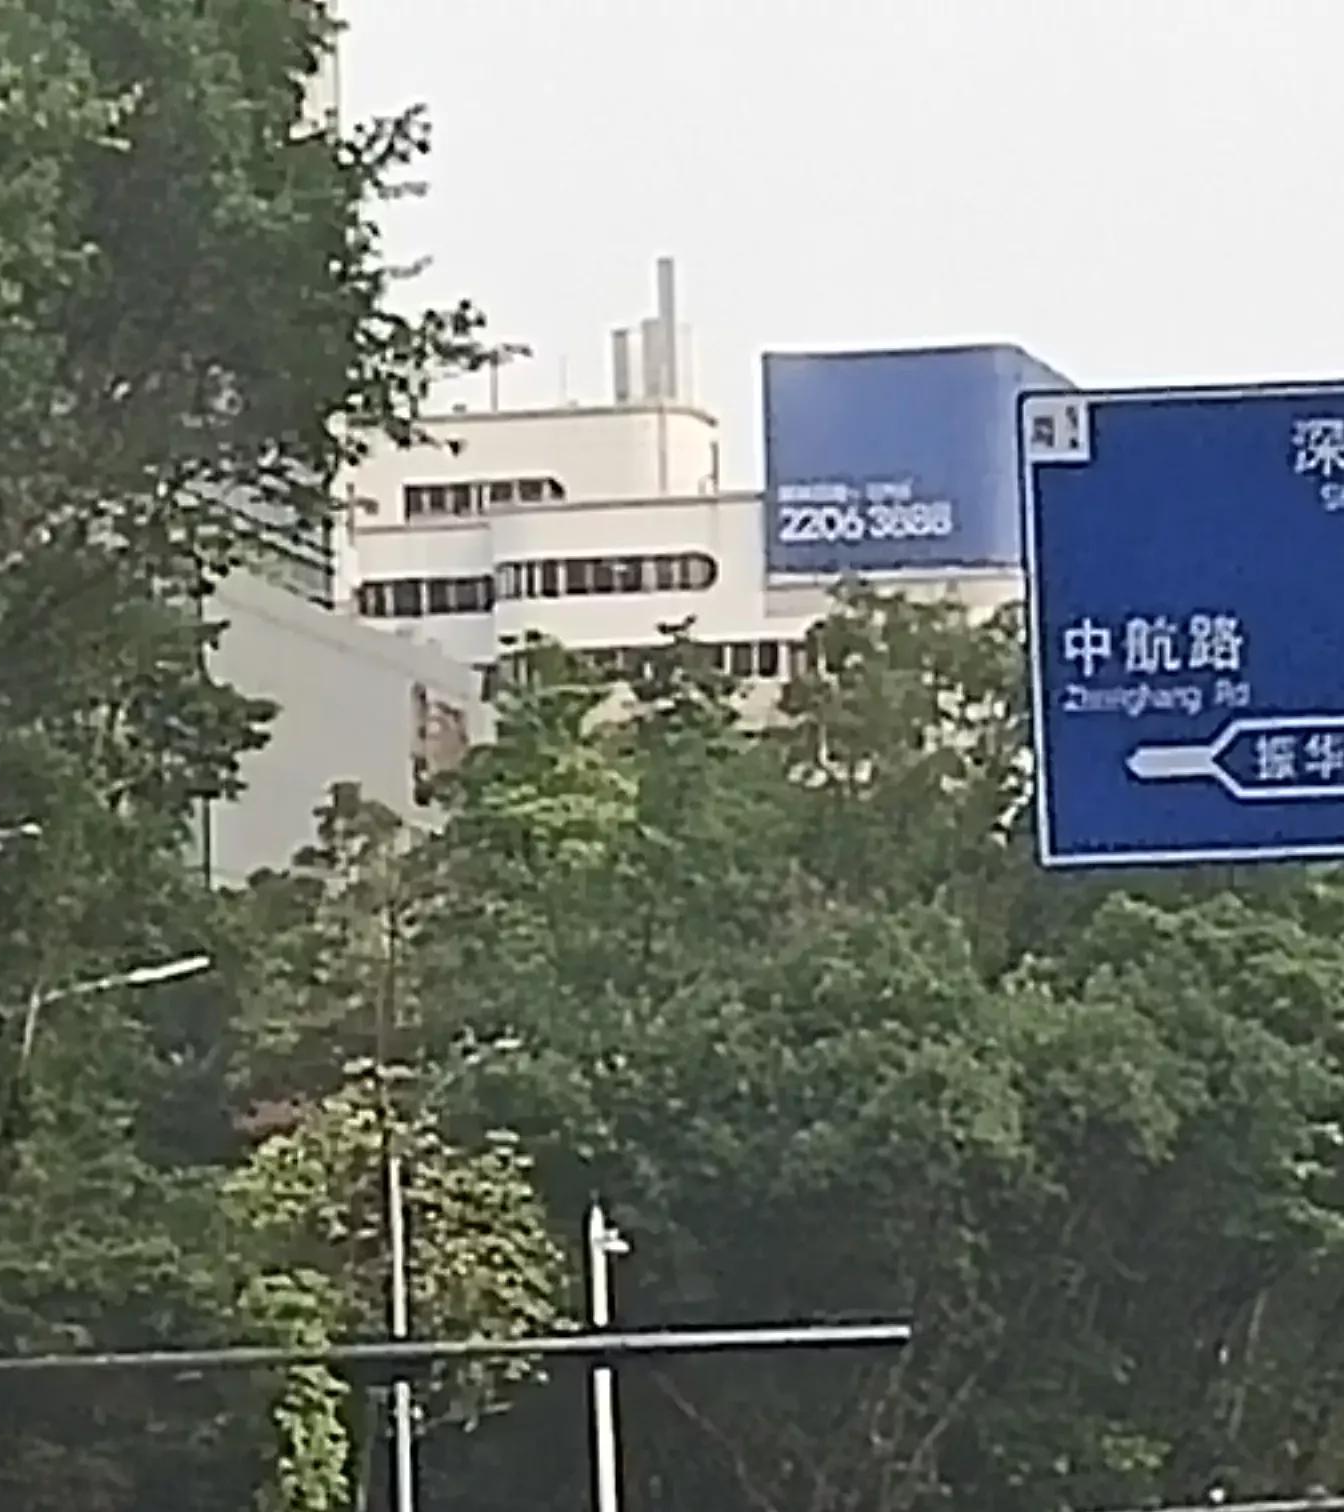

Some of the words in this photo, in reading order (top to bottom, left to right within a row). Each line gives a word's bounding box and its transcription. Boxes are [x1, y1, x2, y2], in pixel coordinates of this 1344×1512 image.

[779, 505, 865, 543] 2206
[1064, 614, 1243, 677] 中航路
[1215, 678, 1250, 707] Rd
